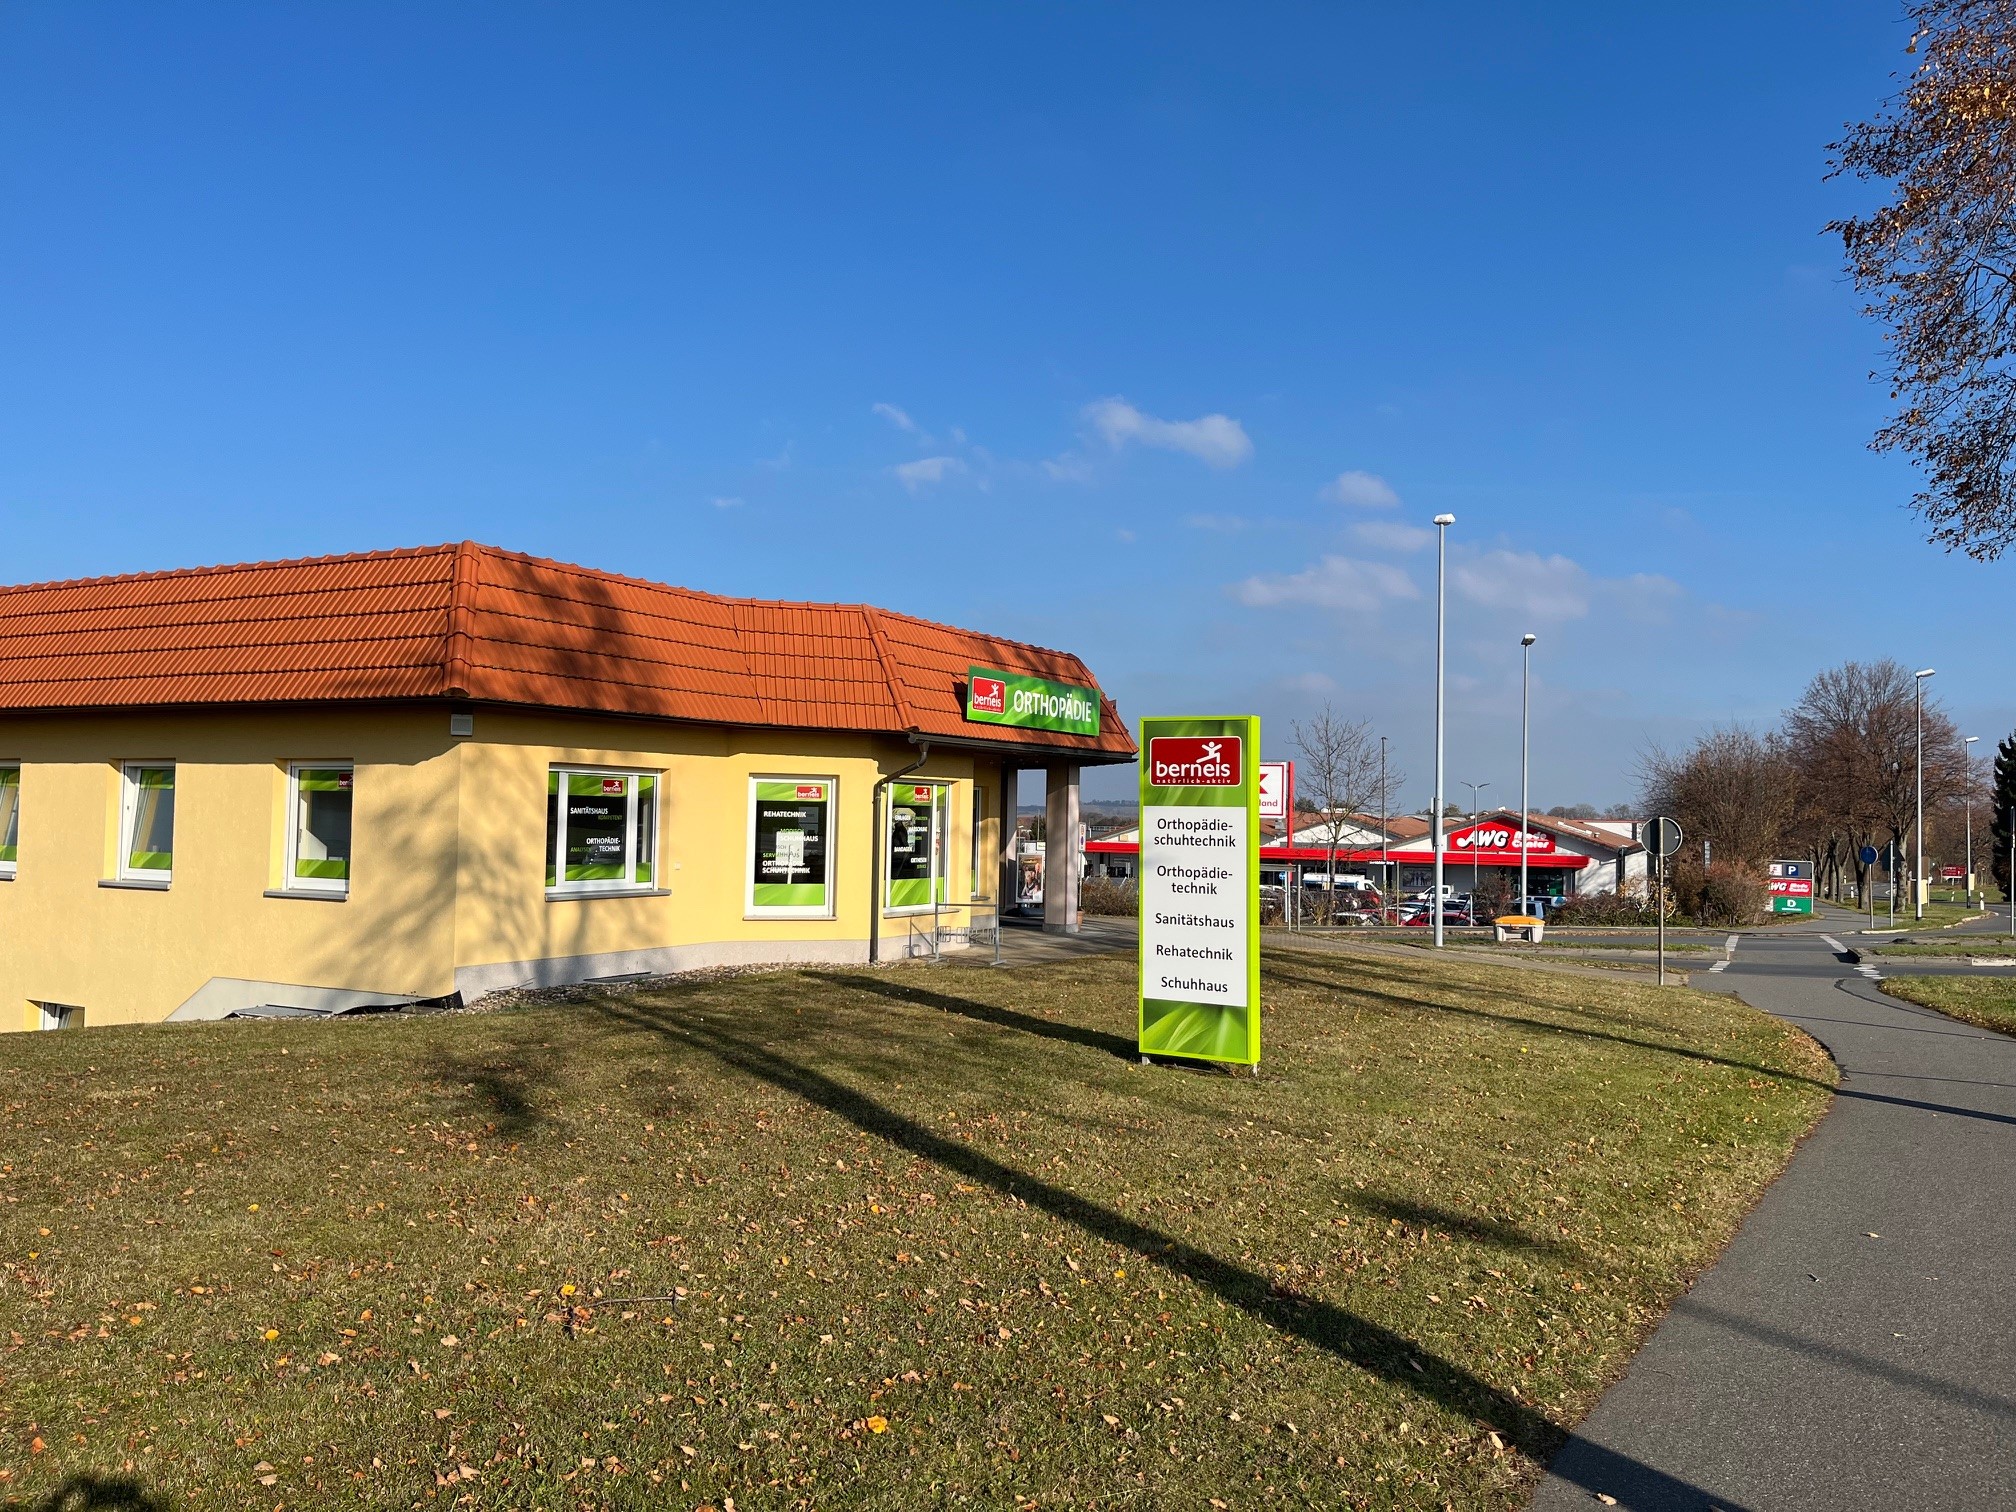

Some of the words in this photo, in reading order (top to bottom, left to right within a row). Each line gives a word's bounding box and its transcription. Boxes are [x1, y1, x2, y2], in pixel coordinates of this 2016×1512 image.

[974, 692, 1002, 708] berneis
[1013, 689, 1092, 722] ORTHOPÄDIE
[1156, 761, 1231, 778] berneis
[570, 806, 608, 814] SANITÄTSHAUS
[1157, 818, 1233, 833] Orthopädie-
[1154, 833, 1236, 848] schuhtechnik
[1456, 830, 1509, 847] AWG
[1156, 865, 1233, 881] Orthopädie-
[1789, 866, 1796, 875] P
[1171, 882, 1218, 895] technik
[1155, 912, 1235, 929] Sanitätshaus
[1156, 944, 1233, 961] Rehatechnik
[1161, 976, 1228, 993] Schuhhaus
